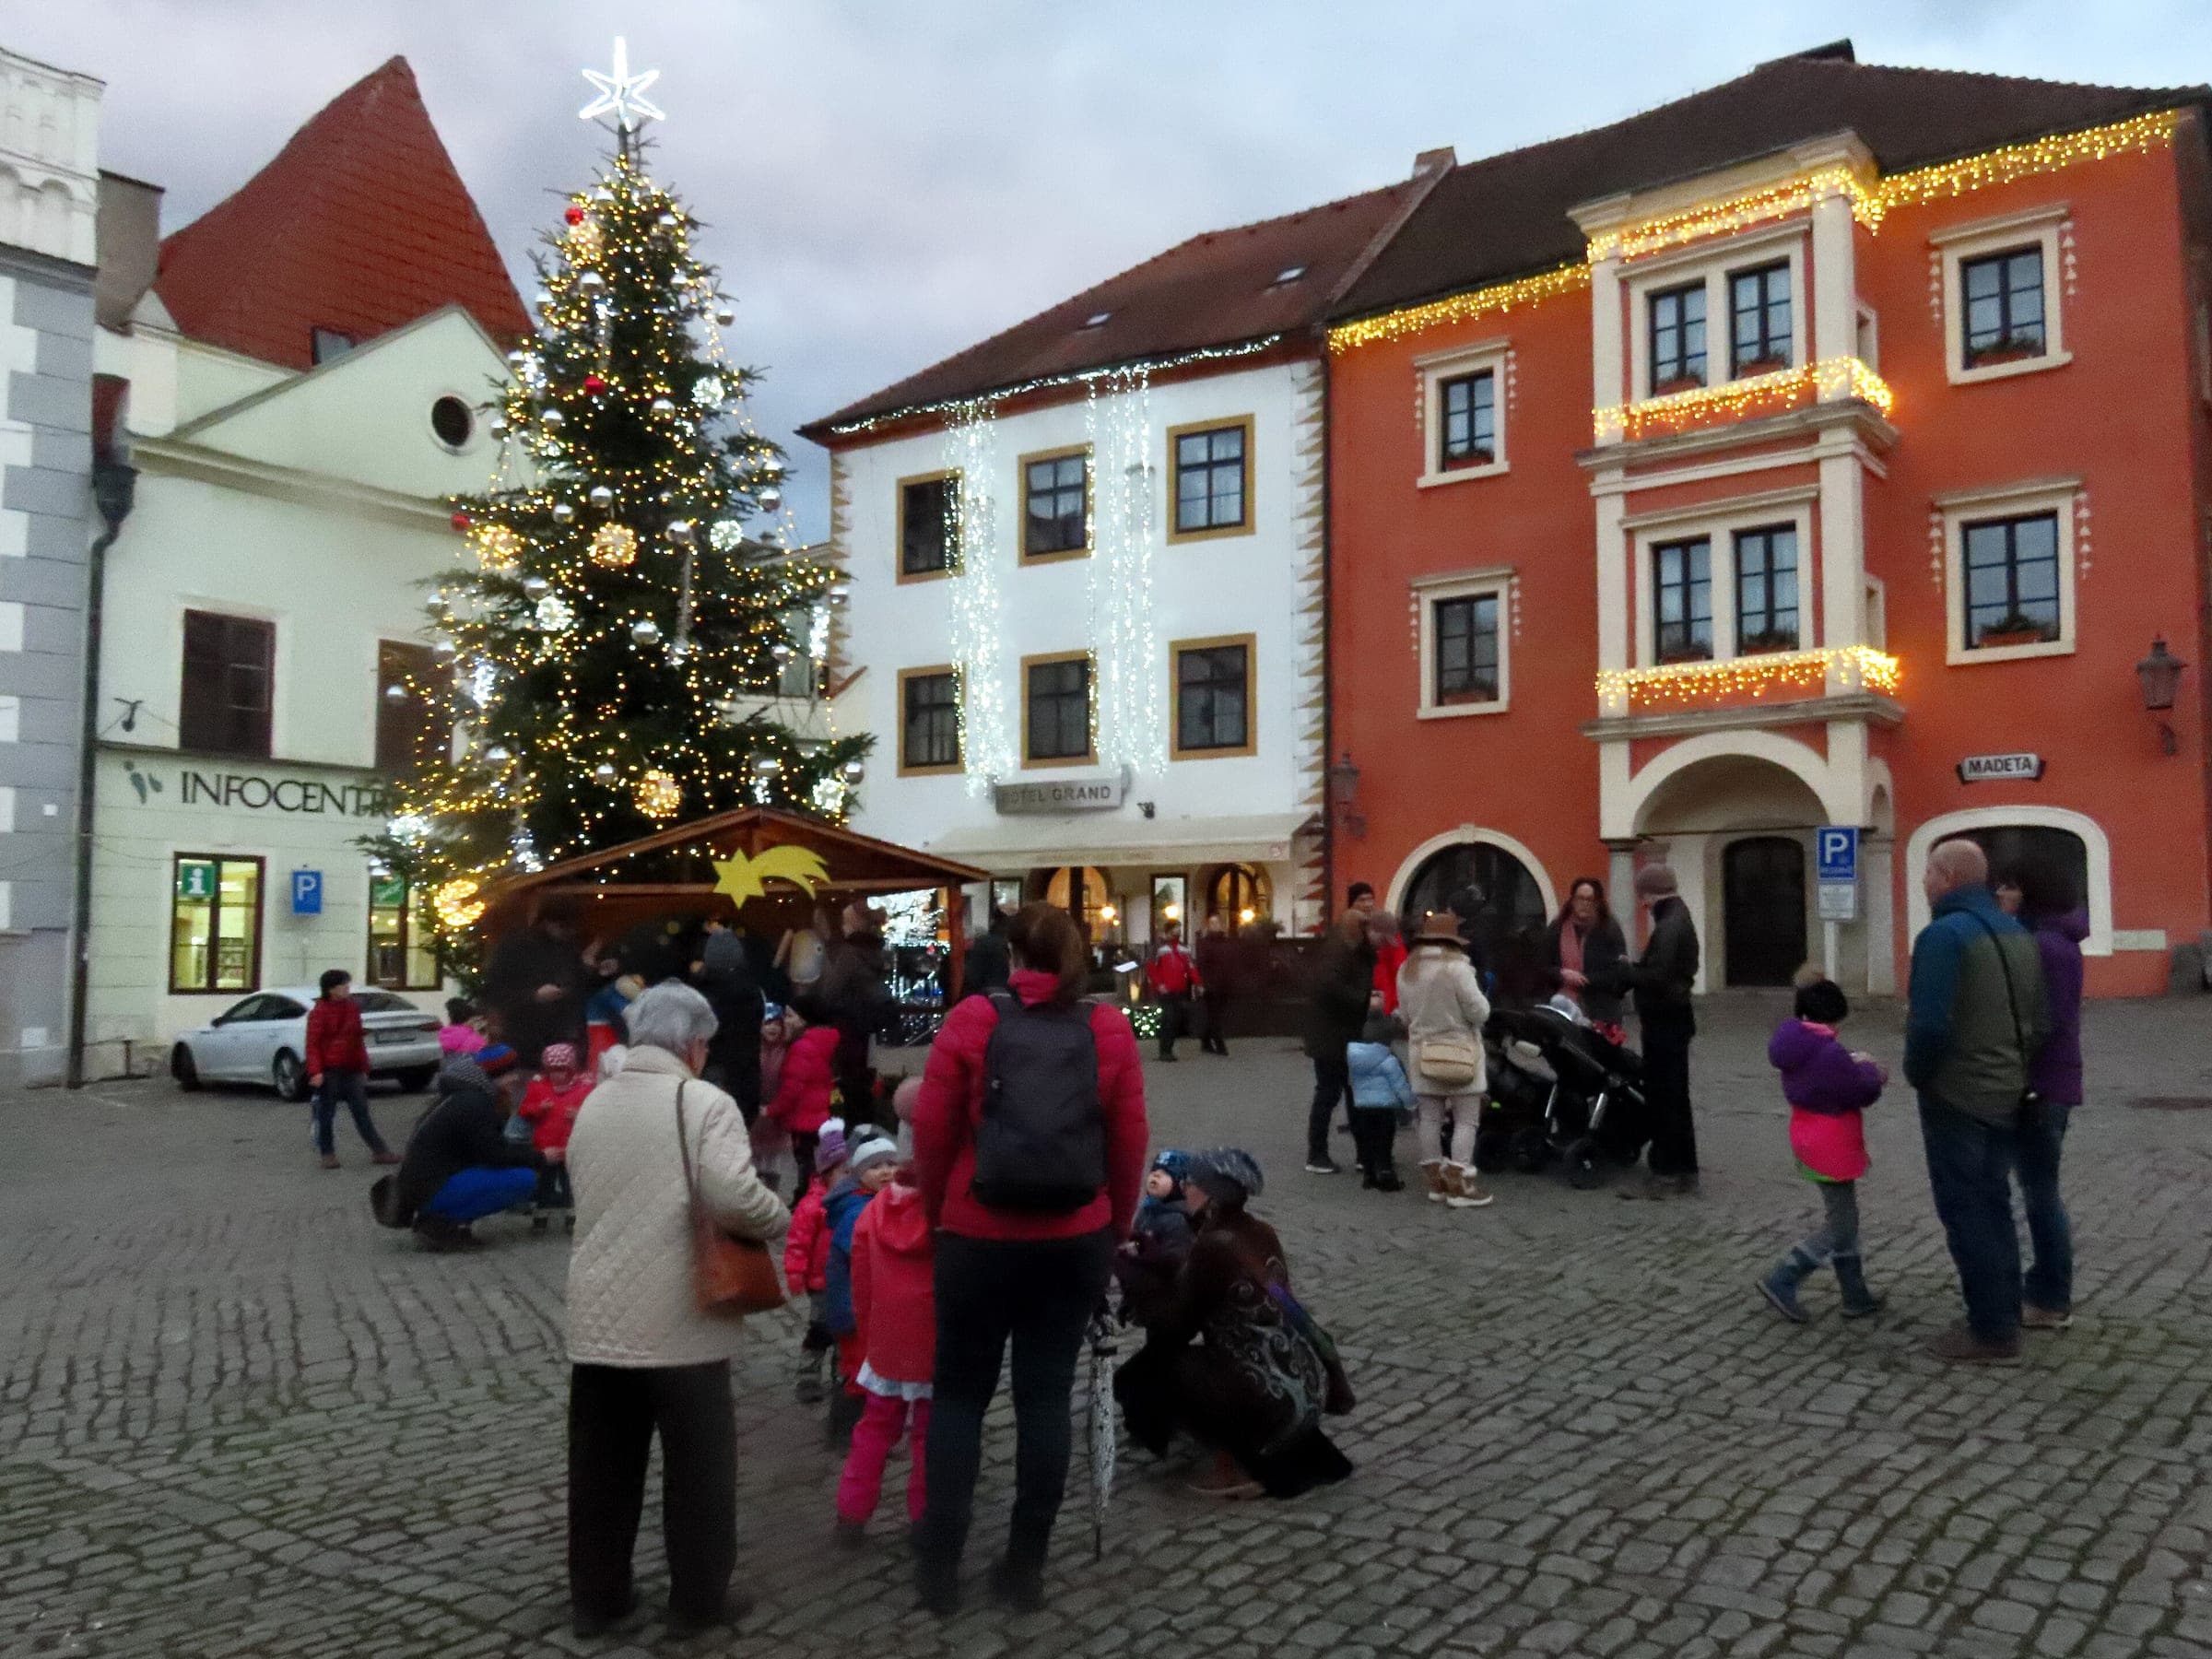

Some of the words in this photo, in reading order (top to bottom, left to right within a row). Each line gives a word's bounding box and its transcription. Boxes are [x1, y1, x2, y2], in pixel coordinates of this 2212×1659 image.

[1968, 757, 2032, 772] MADETA
[1052, 786, 1112, 801] GRAND
[1825, 833, 1849, 864] P
[297, 875, 317, 900] P
